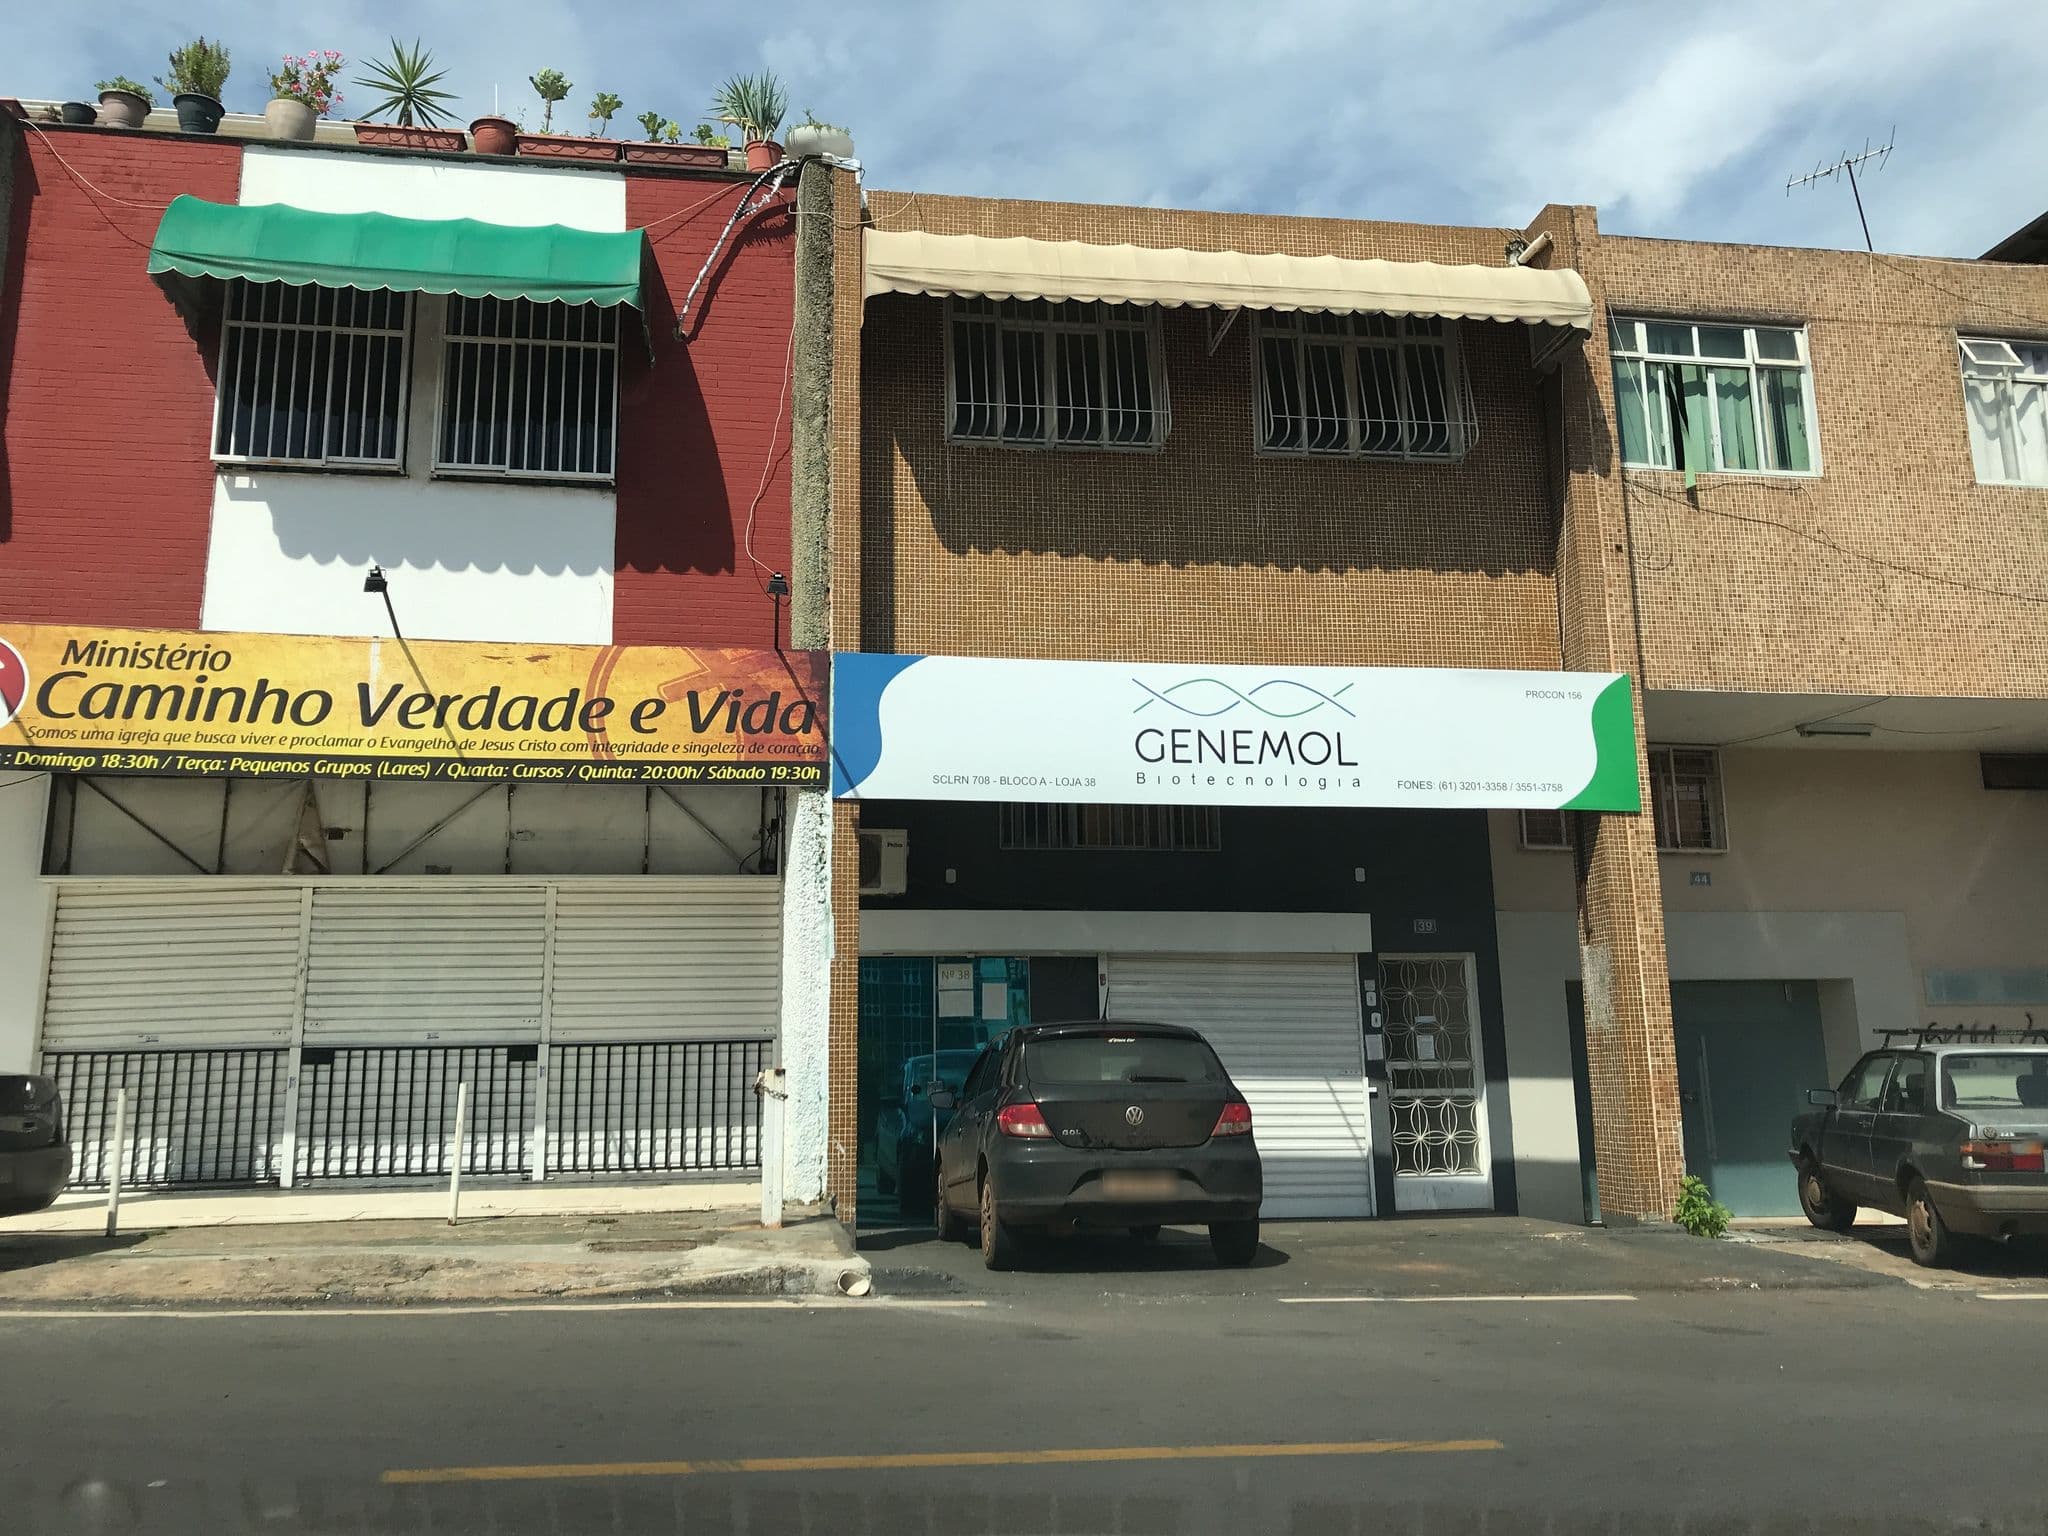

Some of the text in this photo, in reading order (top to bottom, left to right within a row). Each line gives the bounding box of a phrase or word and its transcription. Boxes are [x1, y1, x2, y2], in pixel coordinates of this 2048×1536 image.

[60, 638, 232, 672] Ministério
[36, 670, 816, 735] Caminho Verdade e Vida
[1525, 690, 1583, 700] PROCON 156
[26, 725, 77, 740] Somos
[80, 729, 115, 741] uma
[118, 728, 159, 745] igreja
[163, 732, 191, 746] que
[194, 729, 236, 745] busca
[240, 732, 276, 746] viver
[278, 737, 288, 746] e
[289, 734, 364, 750] proclamar
[367, 739, 377, 748] o
[380, 736, 456, 753] Evangelho
[459, 739, 476, 751] de
[479, 739, 515, 752] Jesus
[518, 739, 557, 752] Cristo
[560, 743, 589, 752] com
[592, 740, 669, 757] integridade
[671, 745, 680, 754] e
[683, 741, 745, 757] singeleza
[748, 742, 764, 754] de
[1135, 728, 1358, 766] GENEMOL
[14, 751, 95, 772] Domingo
[101, 753, 159, 769] 18:30h
[175, 756, 227, 774] Terça:
[230, 757, 310, 776] Pequenos
[313, 760, 372, 777] Grupos
[377, 761, 431, 778] (Lares)
[447, 762, 509, 779] Quarta:
[512, 764, 564, 778] Cursos
[578, 765, 638, 781] Quinta:
[707, 765, 766, 780] Sábado
[771, 766, 821, 780] 19:30h
[932, 775, 969, 784] SCLRN
[973, 776, 990, 785] 708
[1000, 776, 1037, 786] BLOCO
[1039, 777, 1047, 786] A
[1055, 777, 1082, 787] LOJA
[1084, 778, 1096, 787] 38
[1136, 772, 1361, 790] Biotecnologia
[1397, 780, 1435, 790] FONES:
[1438, 780, 1457, 792] (61)
[1459, 781, 1508, 791] 3201-3358
[1516, 783, 1563, 792] 3551-3758
[1418, 921, 1432, 931] 39
